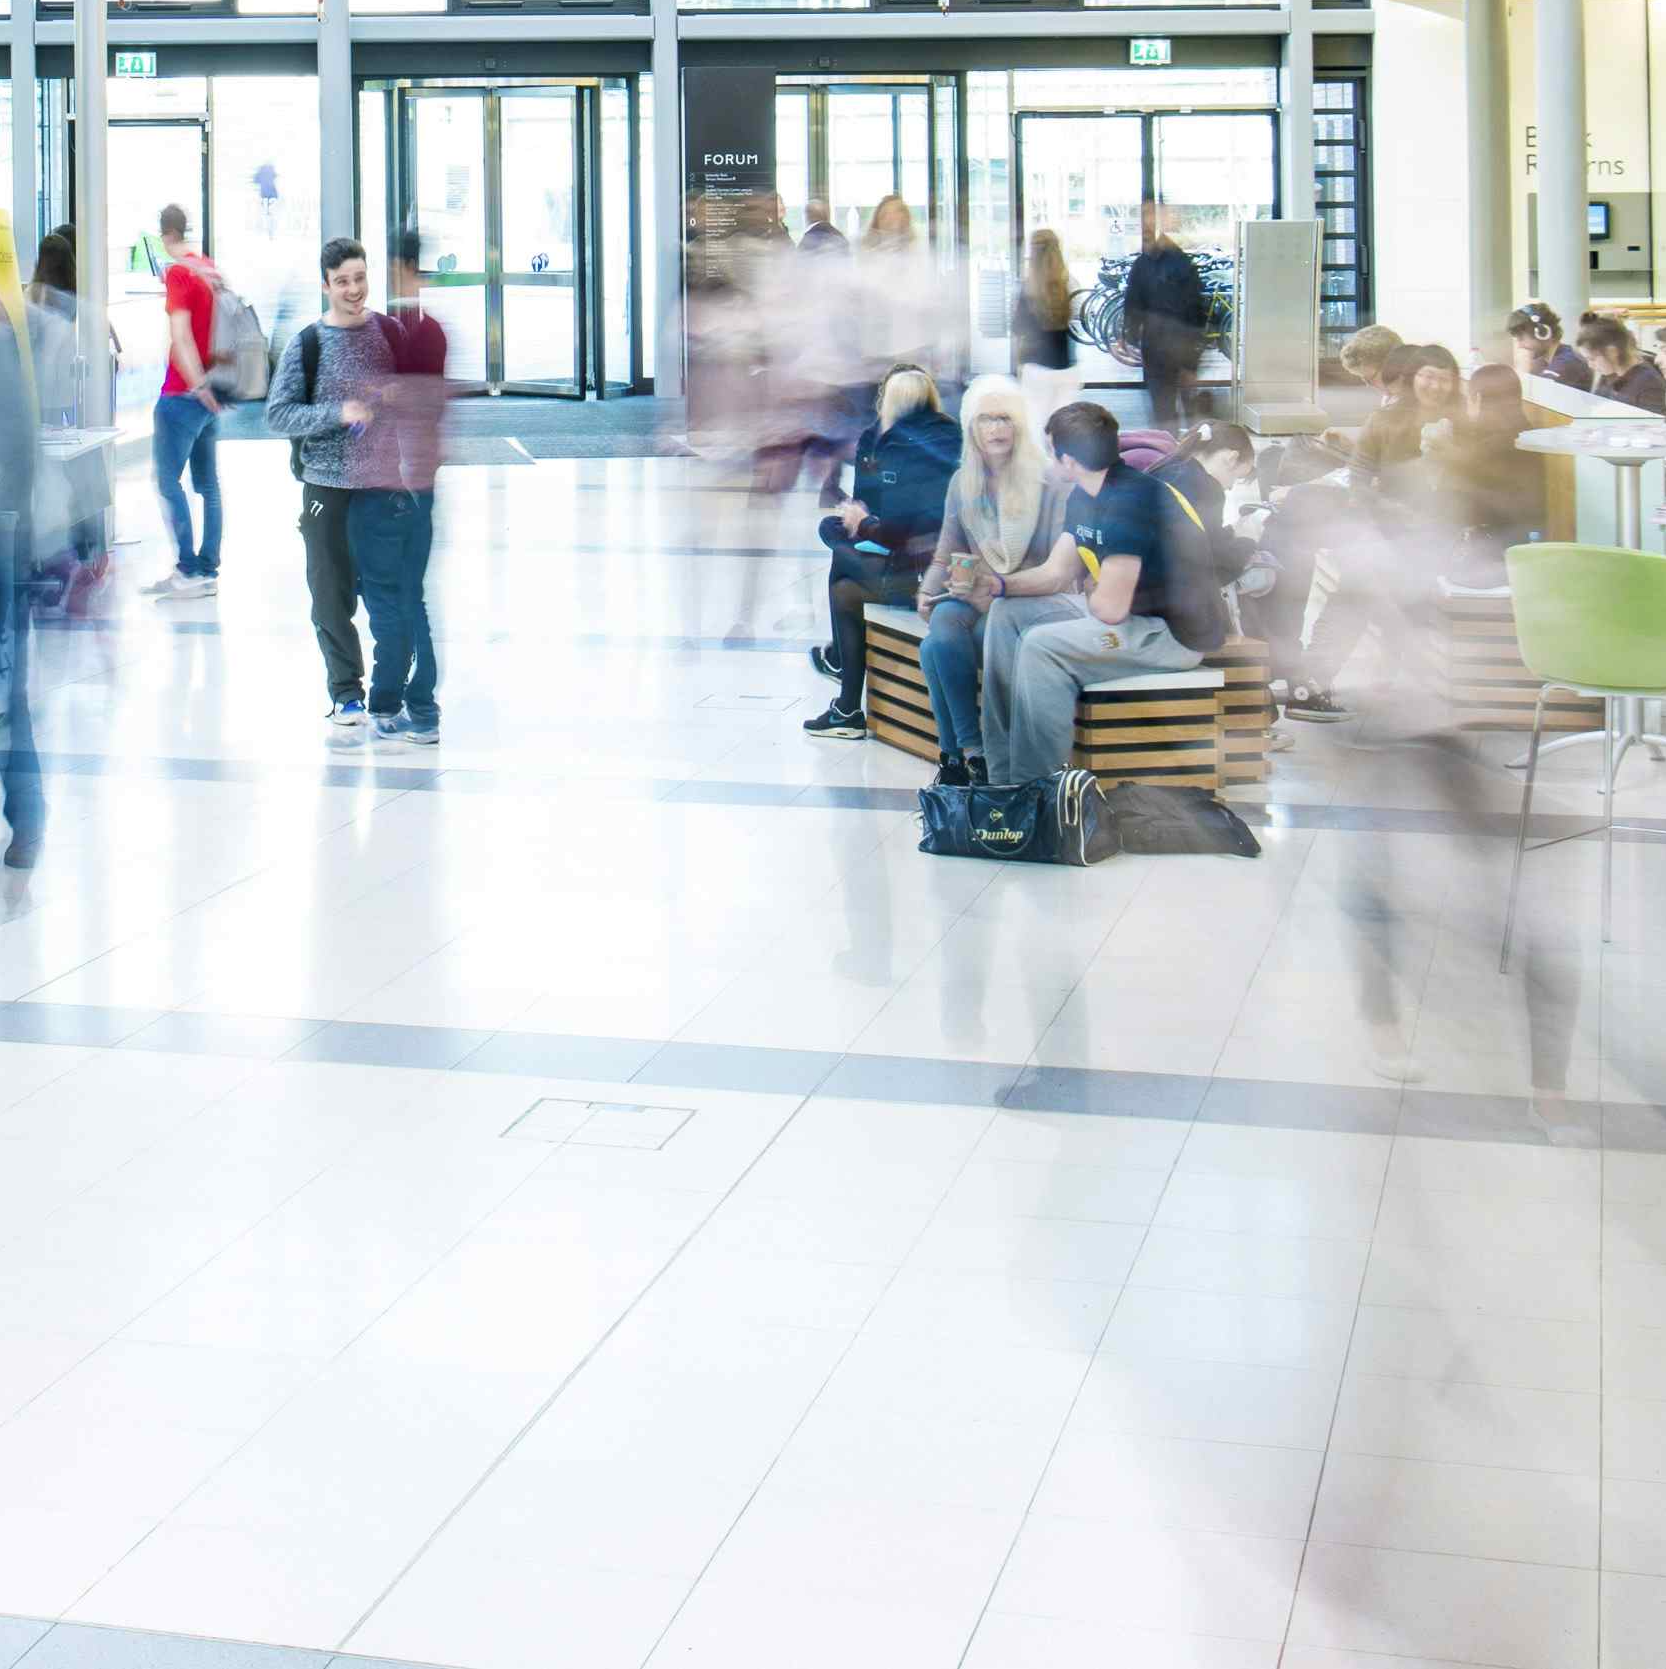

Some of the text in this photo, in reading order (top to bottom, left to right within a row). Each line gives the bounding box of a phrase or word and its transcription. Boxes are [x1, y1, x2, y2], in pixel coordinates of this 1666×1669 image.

[1525, 125, 1593, 148] Bk
[704, 153, 758, 165] FORUM
[1526, 153, 1625, 176] Rrns
[972, 827, 1024, 844] Dunlop
